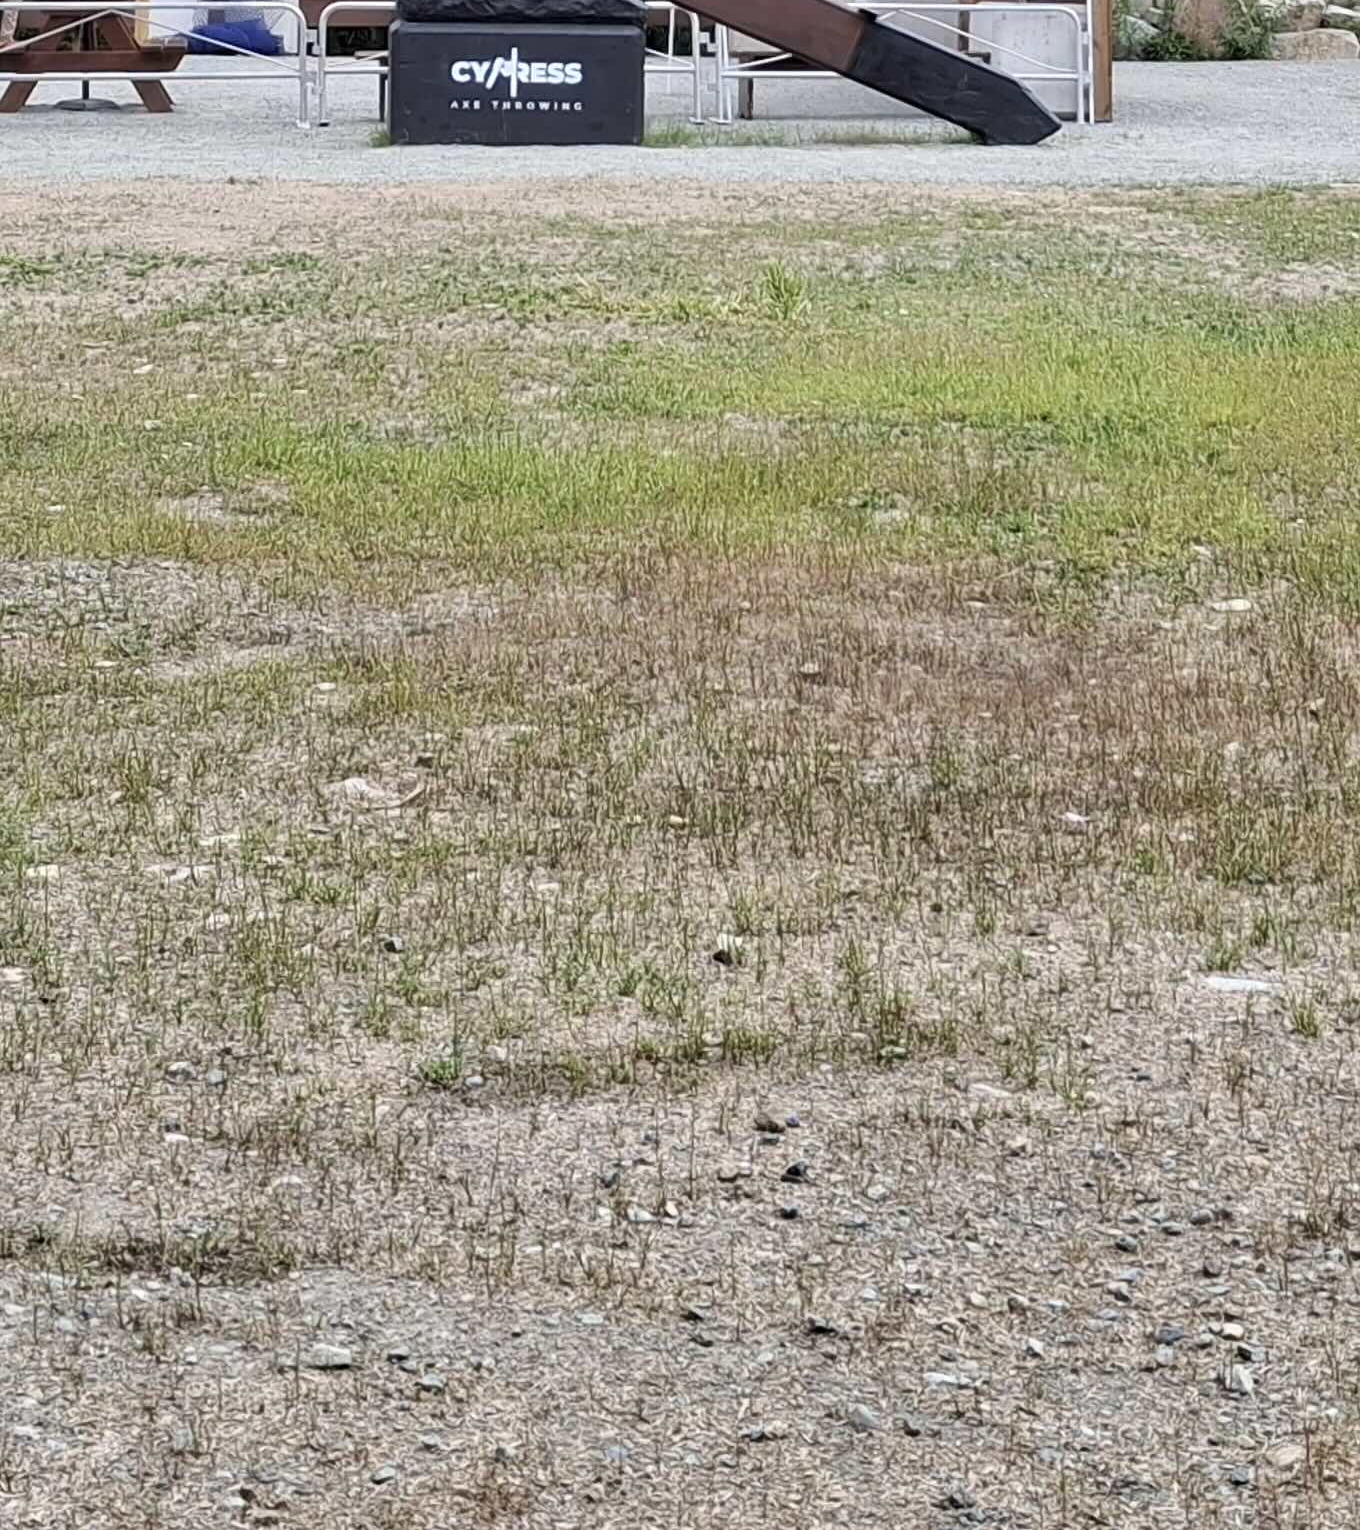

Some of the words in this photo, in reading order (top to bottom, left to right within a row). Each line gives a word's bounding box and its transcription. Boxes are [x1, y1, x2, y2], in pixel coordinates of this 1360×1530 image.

[451, 47, 583, 98] CYPRESS
[450, 100, 481, 110] AXE
[491, 100, 583, 112] THROWING
